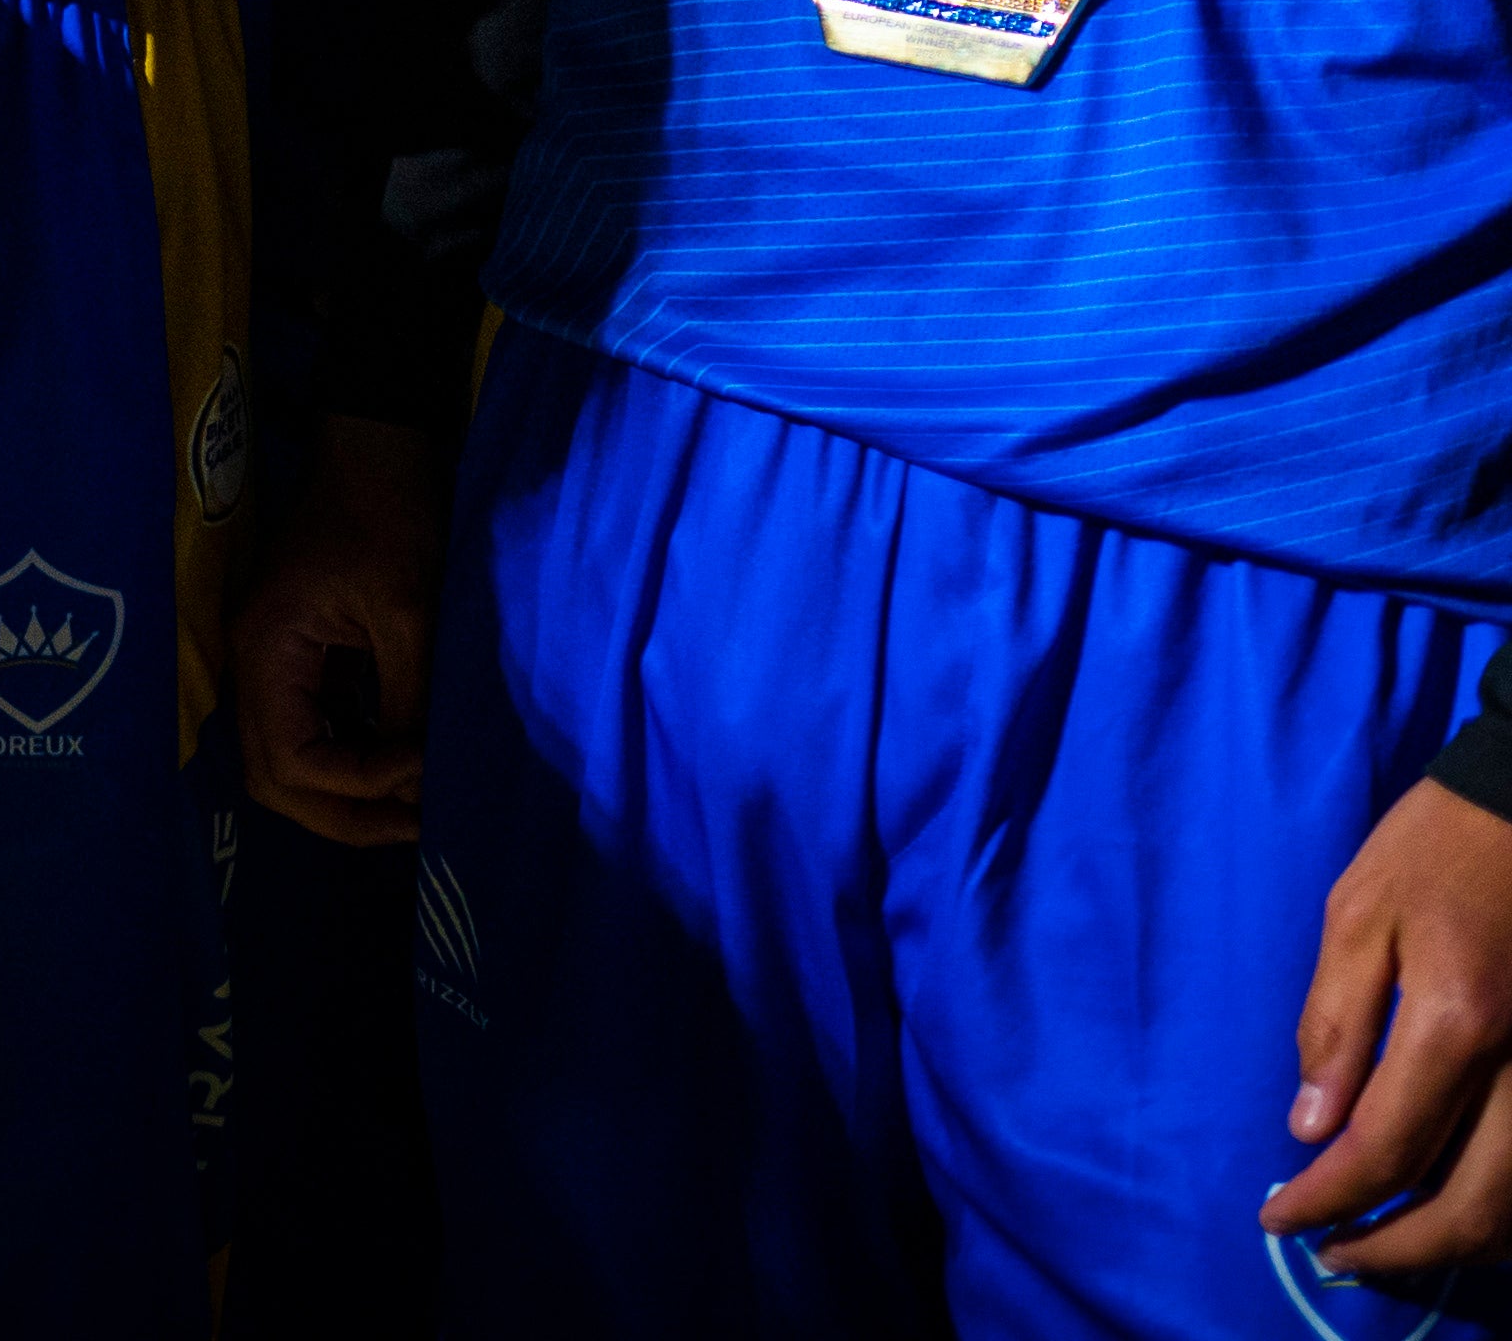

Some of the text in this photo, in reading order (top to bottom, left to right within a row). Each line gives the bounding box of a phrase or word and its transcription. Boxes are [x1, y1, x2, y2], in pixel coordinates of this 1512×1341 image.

[843, 11, 911, 30] EUROPEAN
[906, 35, 956, 49] WINNER
[416, 968, 490, 1030] RIZZLY
